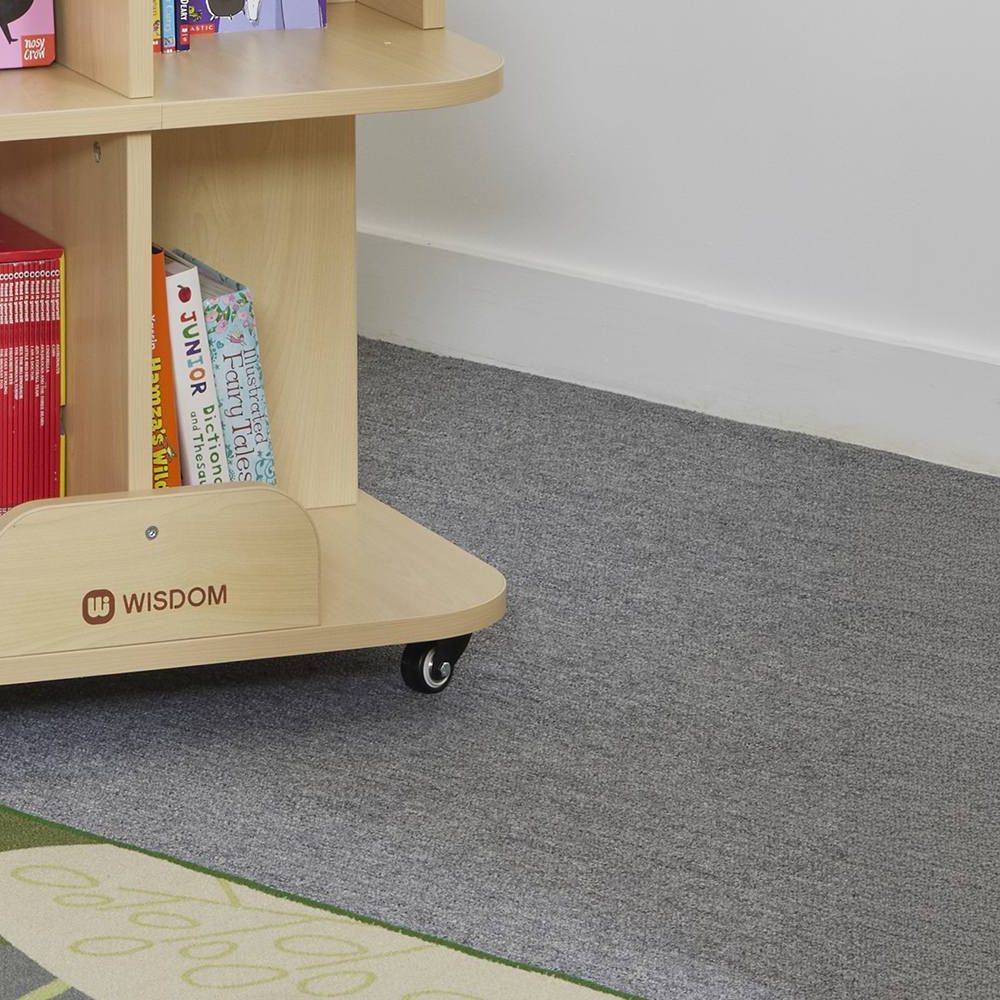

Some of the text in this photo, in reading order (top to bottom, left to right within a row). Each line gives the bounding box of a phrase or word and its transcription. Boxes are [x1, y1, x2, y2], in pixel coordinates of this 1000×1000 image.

[164, 5, 174, 33] Curry
[180, 0, 189, 21] DEARY
[24, 38, 45, 51] nosy
[180, 311, 207, 397] JUNIOR
[152, 357, 167, 446] Hamza's
[243, 348, 267, 445] Illustrated
[191, 411, 201, 431] and
[222, 350, 254, 482] Fairy Tales
[123, 584, 228, 614] WISDOM
